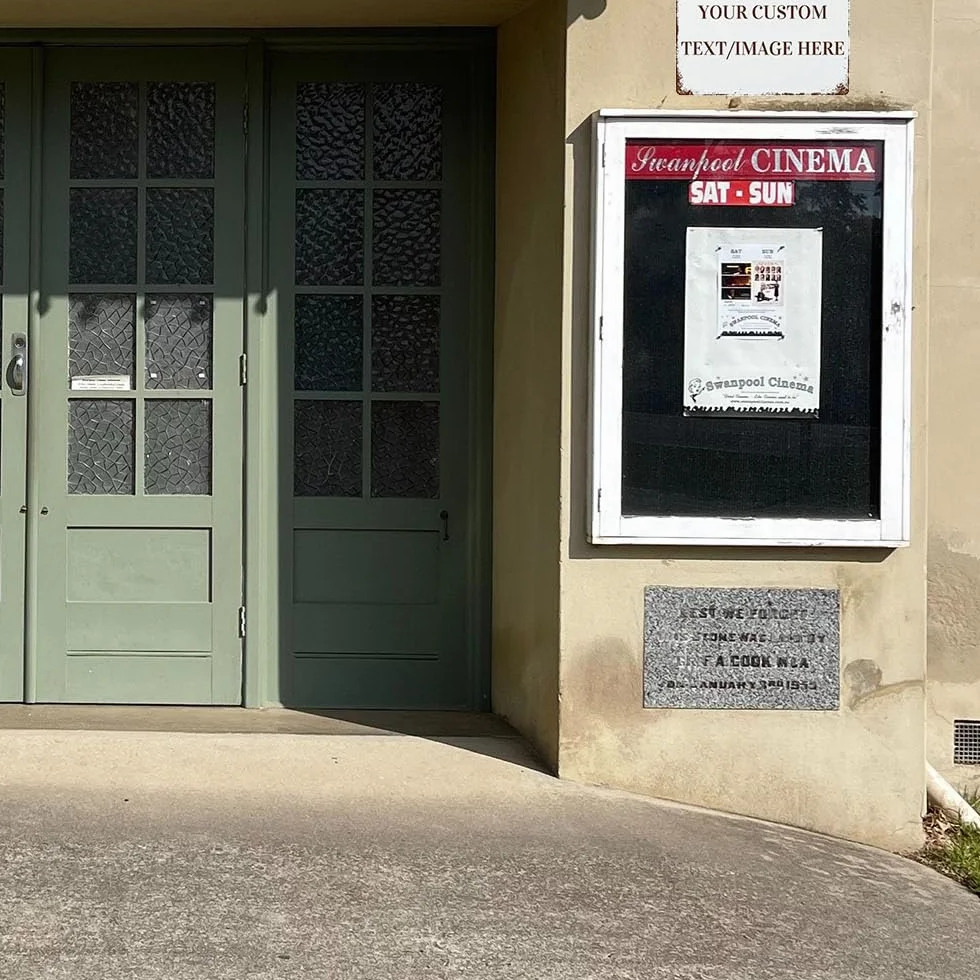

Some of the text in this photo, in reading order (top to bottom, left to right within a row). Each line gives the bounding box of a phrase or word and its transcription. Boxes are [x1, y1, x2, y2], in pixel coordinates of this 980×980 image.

[698, 4, 827, 20] YOUR CUSTOM
[681, 40, 845, 60] TEXT/IMAGE HERE
[631, 145, 876, 180] Swanpool CINEMA
[691, 181, 730, 204] SAT
[749, 181, 792, 204] SUN
[705, 376, 814, 394] Swanpool Cinema
[730, 655, 772, 667] COOK
